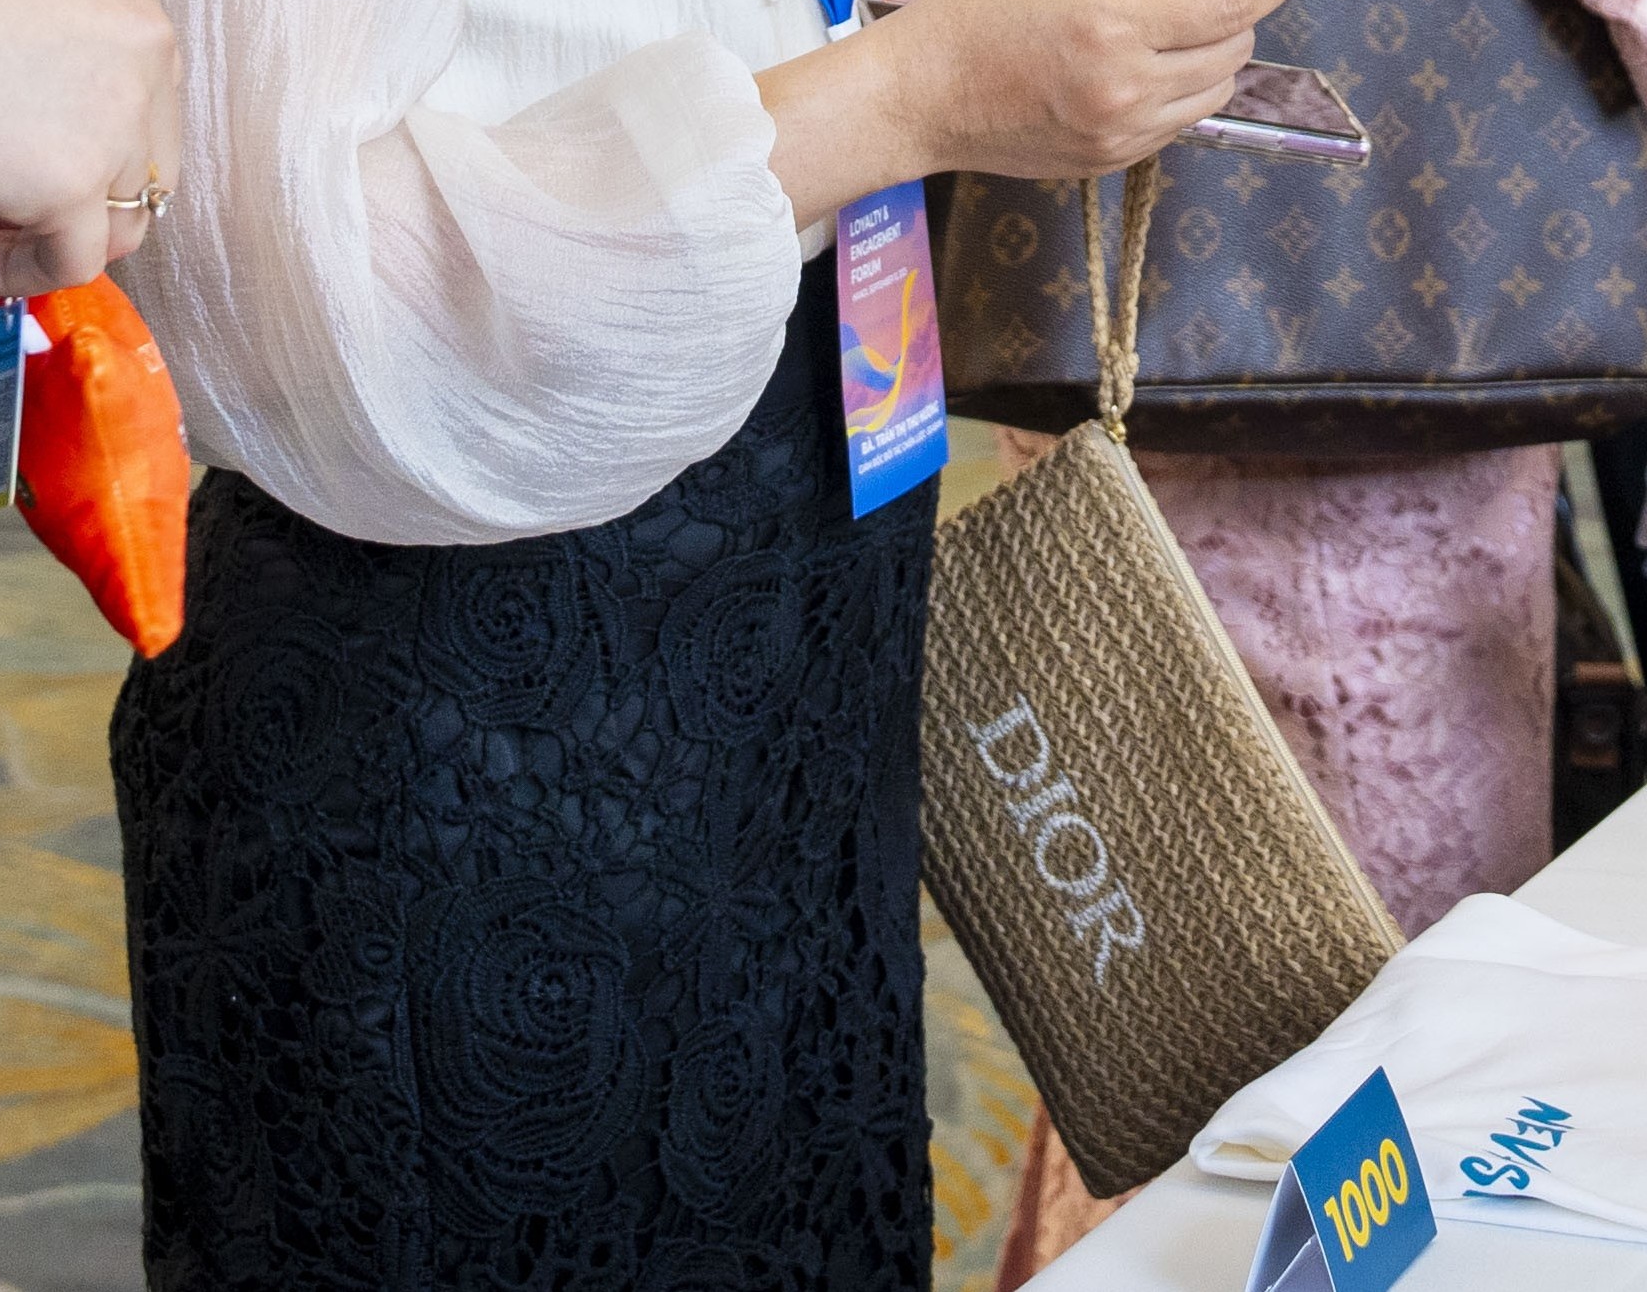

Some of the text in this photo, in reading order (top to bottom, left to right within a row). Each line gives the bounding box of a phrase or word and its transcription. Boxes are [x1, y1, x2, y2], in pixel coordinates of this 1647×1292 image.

[849, 207, 883, 238] LOYALTY
[850, 221, 902, 262] ENGAGEMENT
[851, 257, 882, 285] FORUM
[964, 691, 1147, 986] DIOR
[1323, 1138, 1410, 1263] 1000
